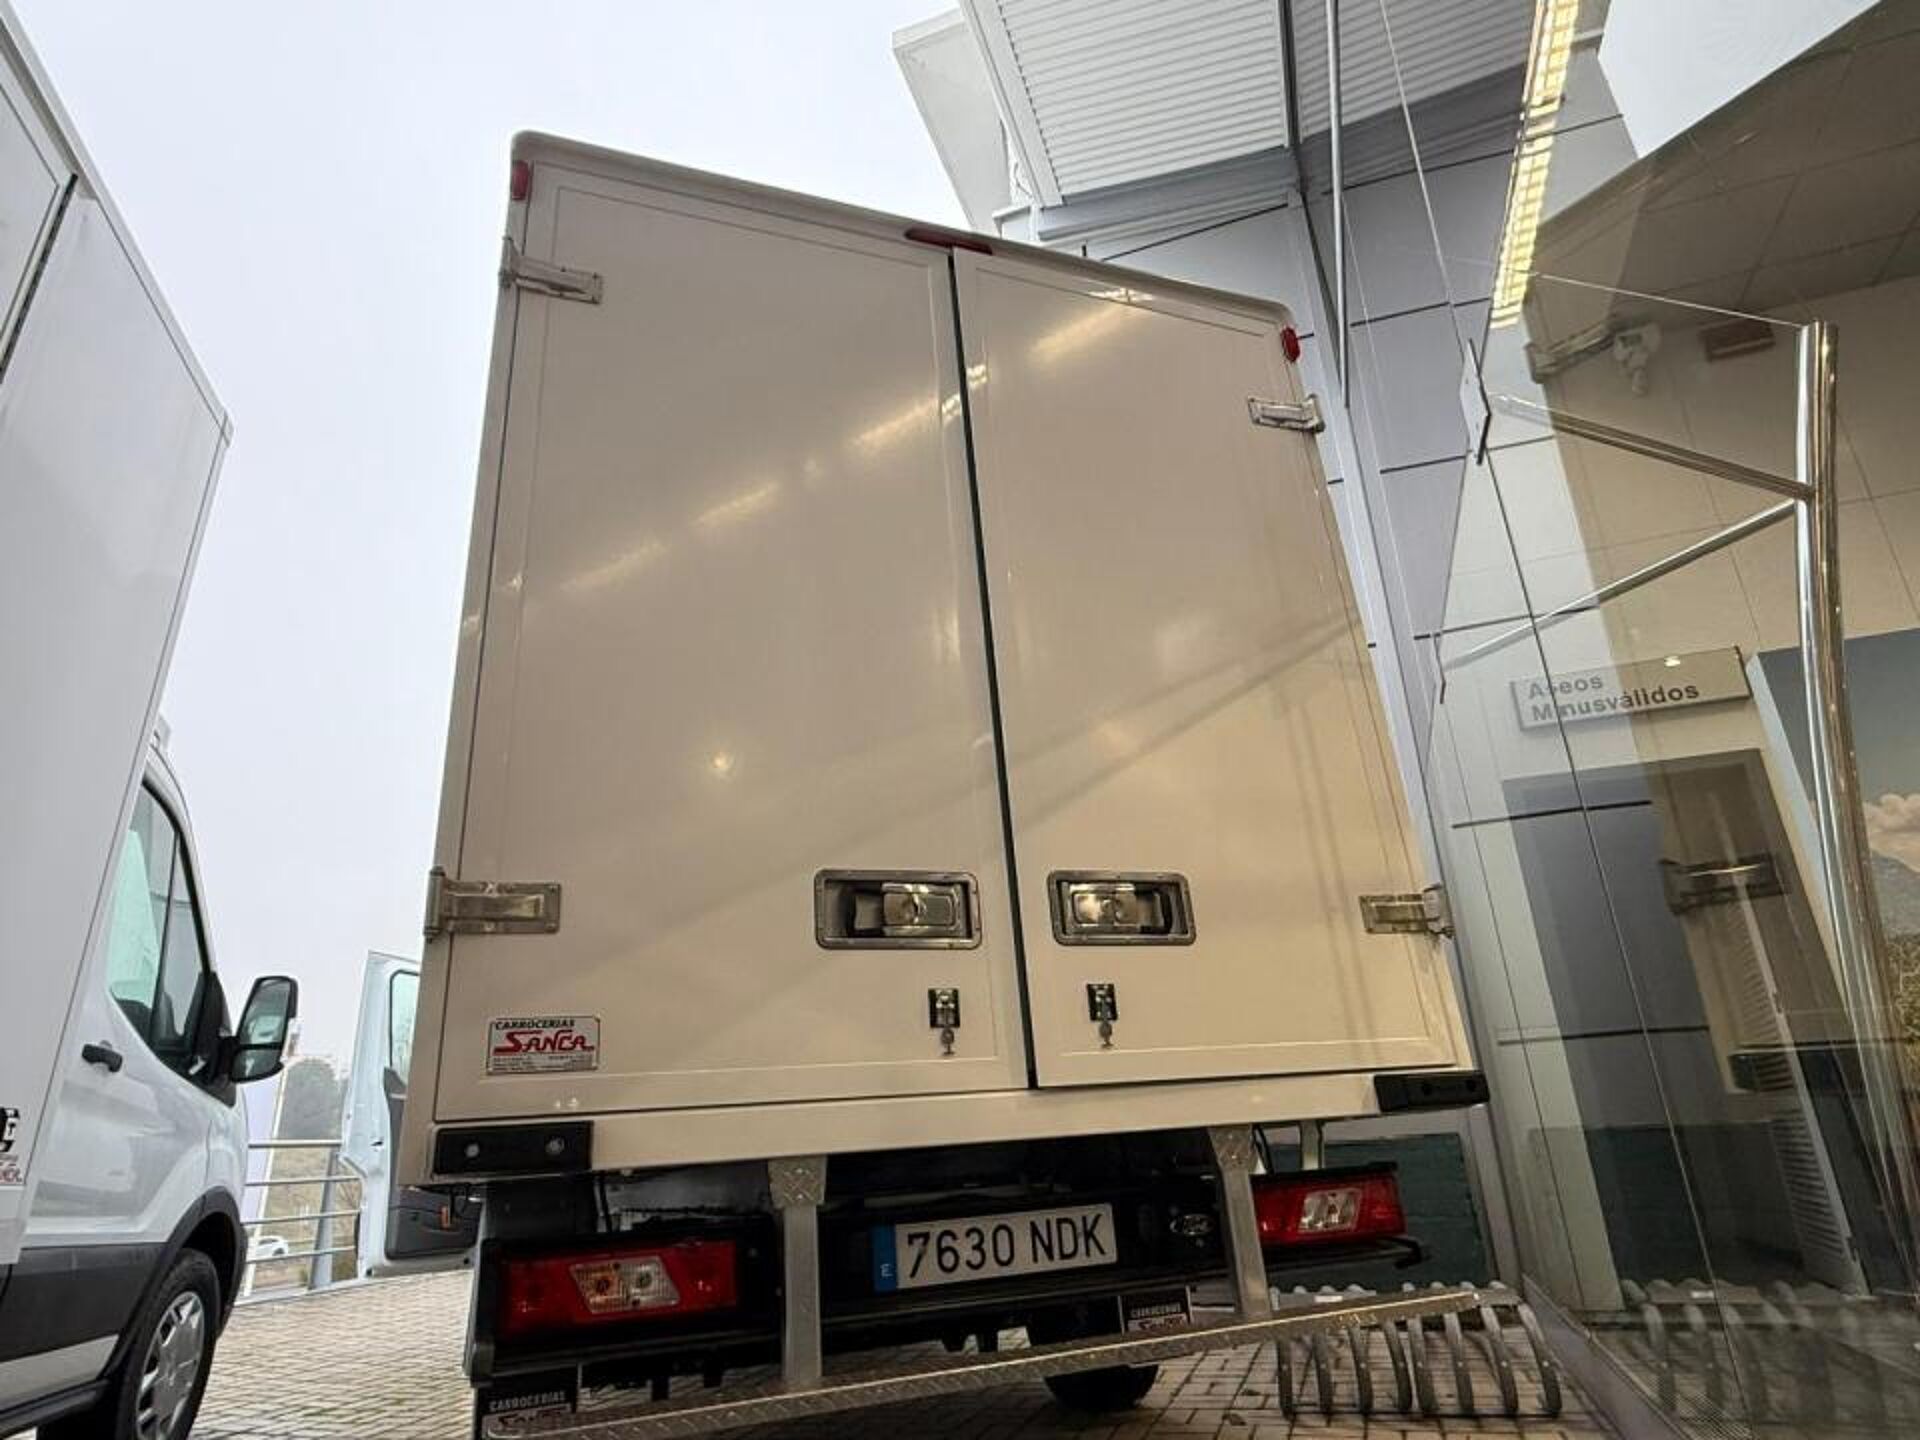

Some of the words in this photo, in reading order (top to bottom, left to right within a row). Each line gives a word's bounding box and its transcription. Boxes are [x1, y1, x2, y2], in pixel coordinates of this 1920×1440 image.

[494, 1029, 595, 1053] SANCA
[907, 1223, 1016, 1279] 7630
[1029, 1212, 1107, 1264] NDK
